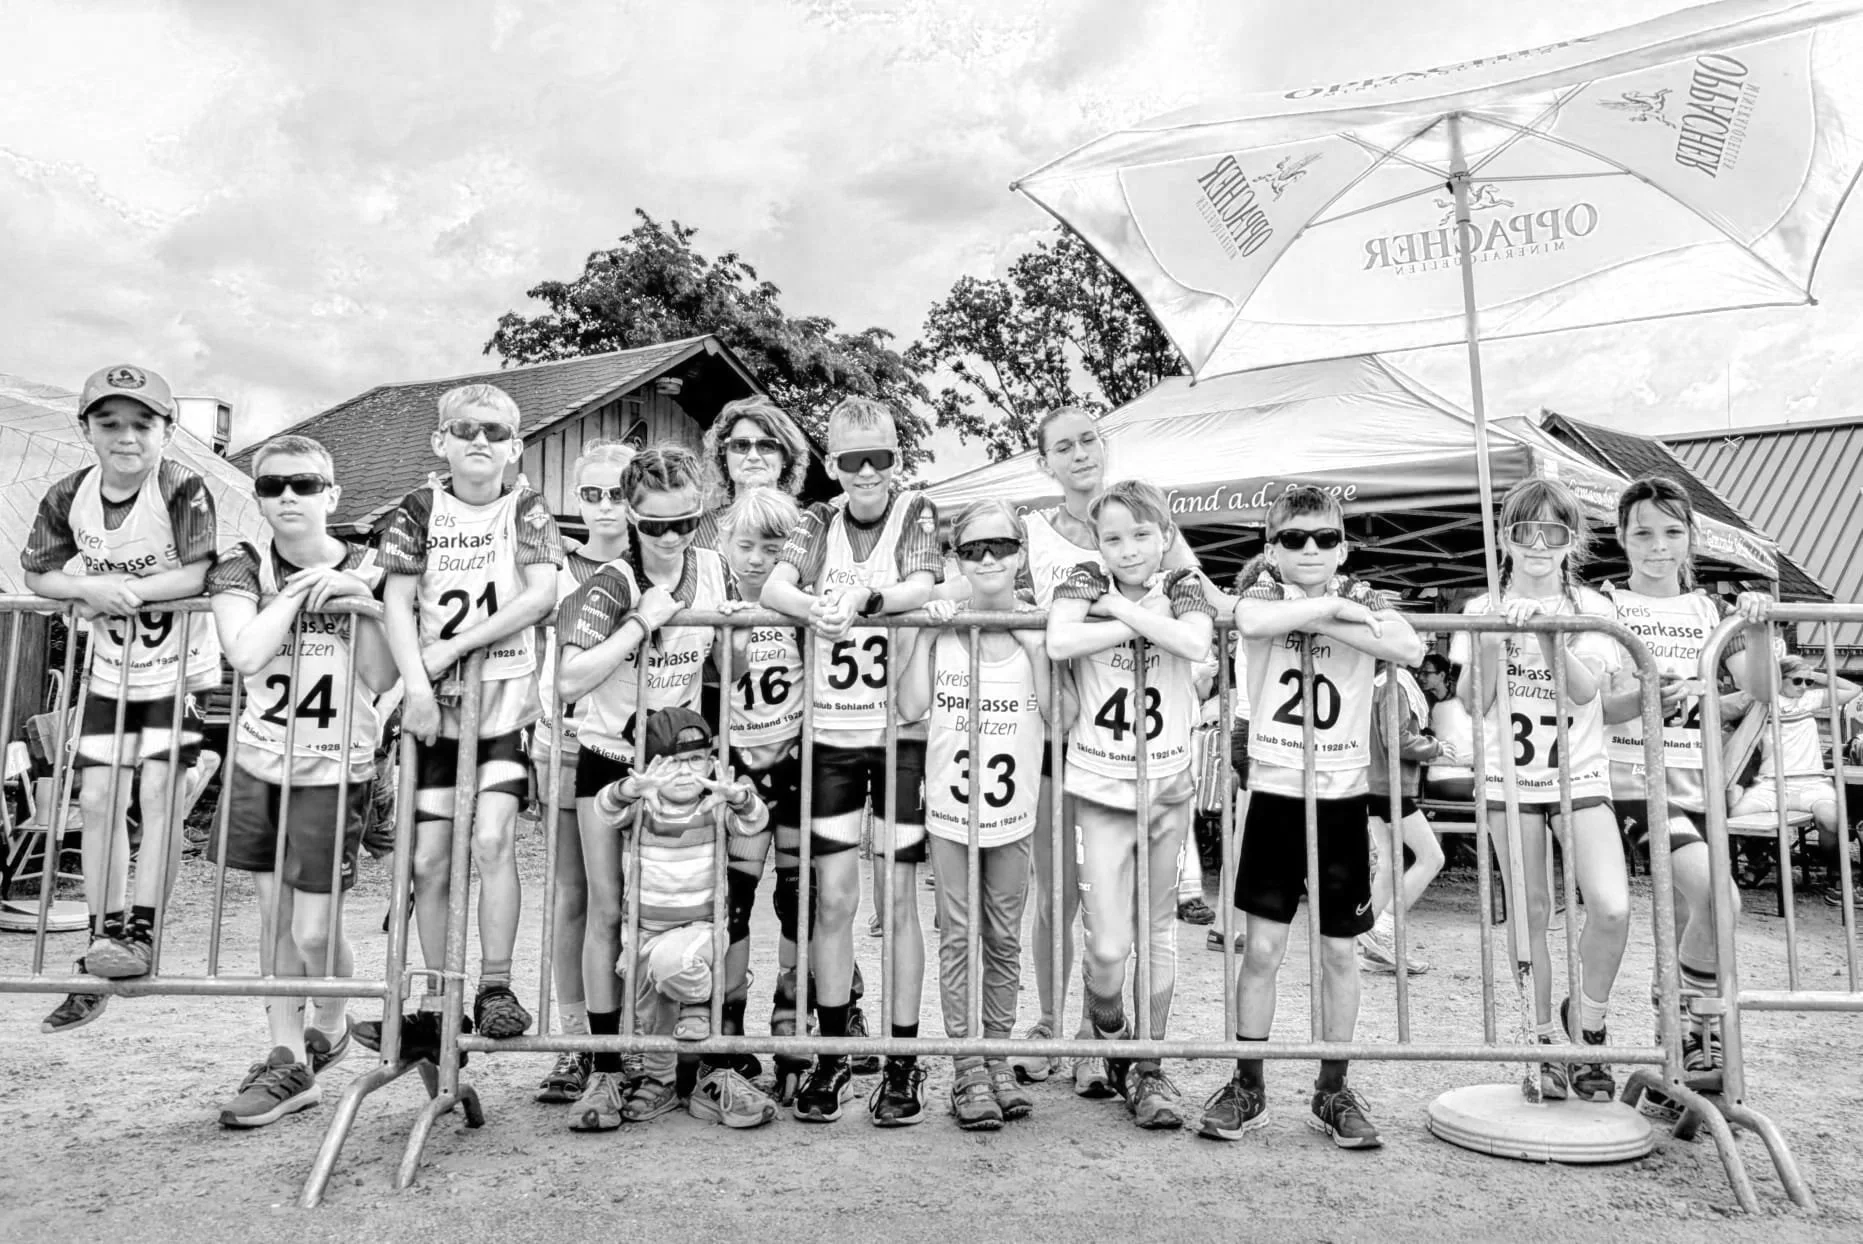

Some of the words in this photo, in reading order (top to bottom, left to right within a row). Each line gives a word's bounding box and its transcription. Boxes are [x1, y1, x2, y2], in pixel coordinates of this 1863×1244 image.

[1167, 485, 1227, 515] land
[84, 553, 157, 573] parkasse
[438, 550, 496, 573] Bautzn
[437, 581, 498, 640] 21
[1615, 604, 1652, 620] Kreis
[1626, 621, 1704, 640] parkasse
[275, 640, 335, 658] autzen
[828, 635, 888, 690] 53
[737, 666, 792, 711] 16
[936, 670, 970, 687] Kreis
[259, 673, 338, 729] 24
[835, 702, 875, 711] Sohland
[1272, 668, 1342, 730] 20
[315, 743, 340, 752] 1928
[1511, 712, 1574, 769] 37
[1664, 740, 1691, 749] hland
[1109, 751, 1137, 763] Sohla
[950, 749, 1017, 808] 33
